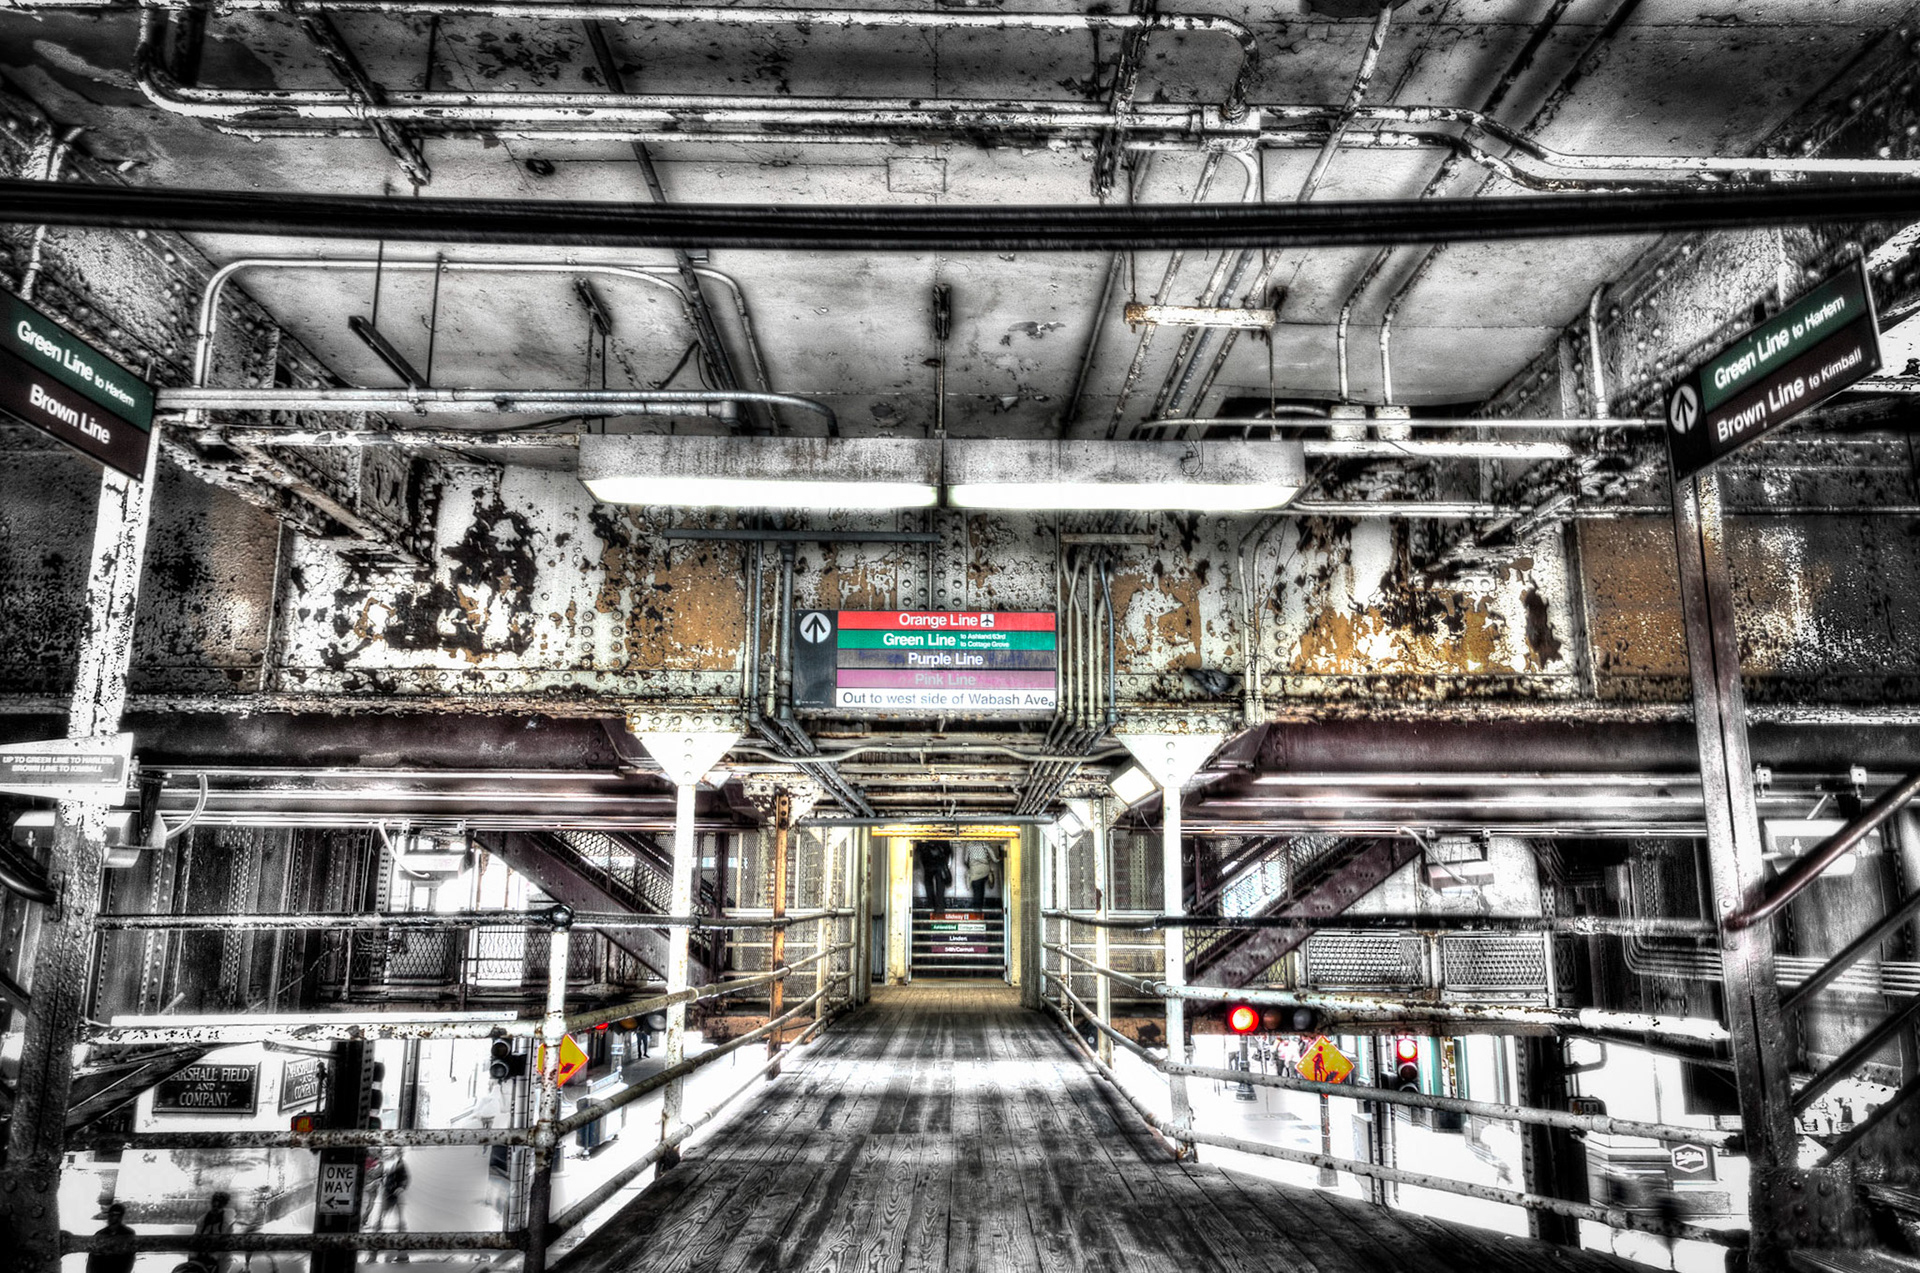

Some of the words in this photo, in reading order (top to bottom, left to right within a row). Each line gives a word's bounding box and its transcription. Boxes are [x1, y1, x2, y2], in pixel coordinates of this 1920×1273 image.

[1715, 351, 1756, 389] Green
[1758, 328, 1790, 362] Line
[1791, 322, 1804, 339] to
[1805, 297, 1844, 331] Harlem
[17, 321, 61, 362] Green
[63, 349, 94, 381] Line
[94, 374, 105, 389] to
[105, 381, 135, 408] Harlem
[1716, 400, 1766, 443] Brown
[1768, 376, 1805, 414] Line
[1808, 373, 1821, 390] to
[1821, 348, 1861, 380] Kimball
[29, 383, 79, 428] Brown
[80, 412, 112, 445] Line
[899, 614, 947, 628] Orange
[950, 613, 978, 626] Line
[883, 633, 924, 646] Green
[928, 633, 956, 646] Line
[908, 652, 951, 668] Purple
[955, 652, 983, 665] Line
[915, 673, 943, 685] Pink
[948, 673, 976, 686] Line
[842, 692, 866, 704] Out
[870, 693, 883, 704] to
[886, 694, 917, 705] west
[920, 693, 948, 705] side
[951, 693, 965, 705] of
[968, 693, 1020, 705] Wabash
[25, 756, 52, 764] GREEN
[52, 756, 69, 764] LINE
[11, 764, 40, 772] BROWN
[169, 1067, 218, 1082] ARSHALL
[221, 1068, 250, 1082] FIELD
[195, 1082, 216, 1091] AND
[179, 1092, 231, 1106] COMPANY
[326, 1167, 355, 1179] ONE
[324, 1181, 353, 1194] WAY
